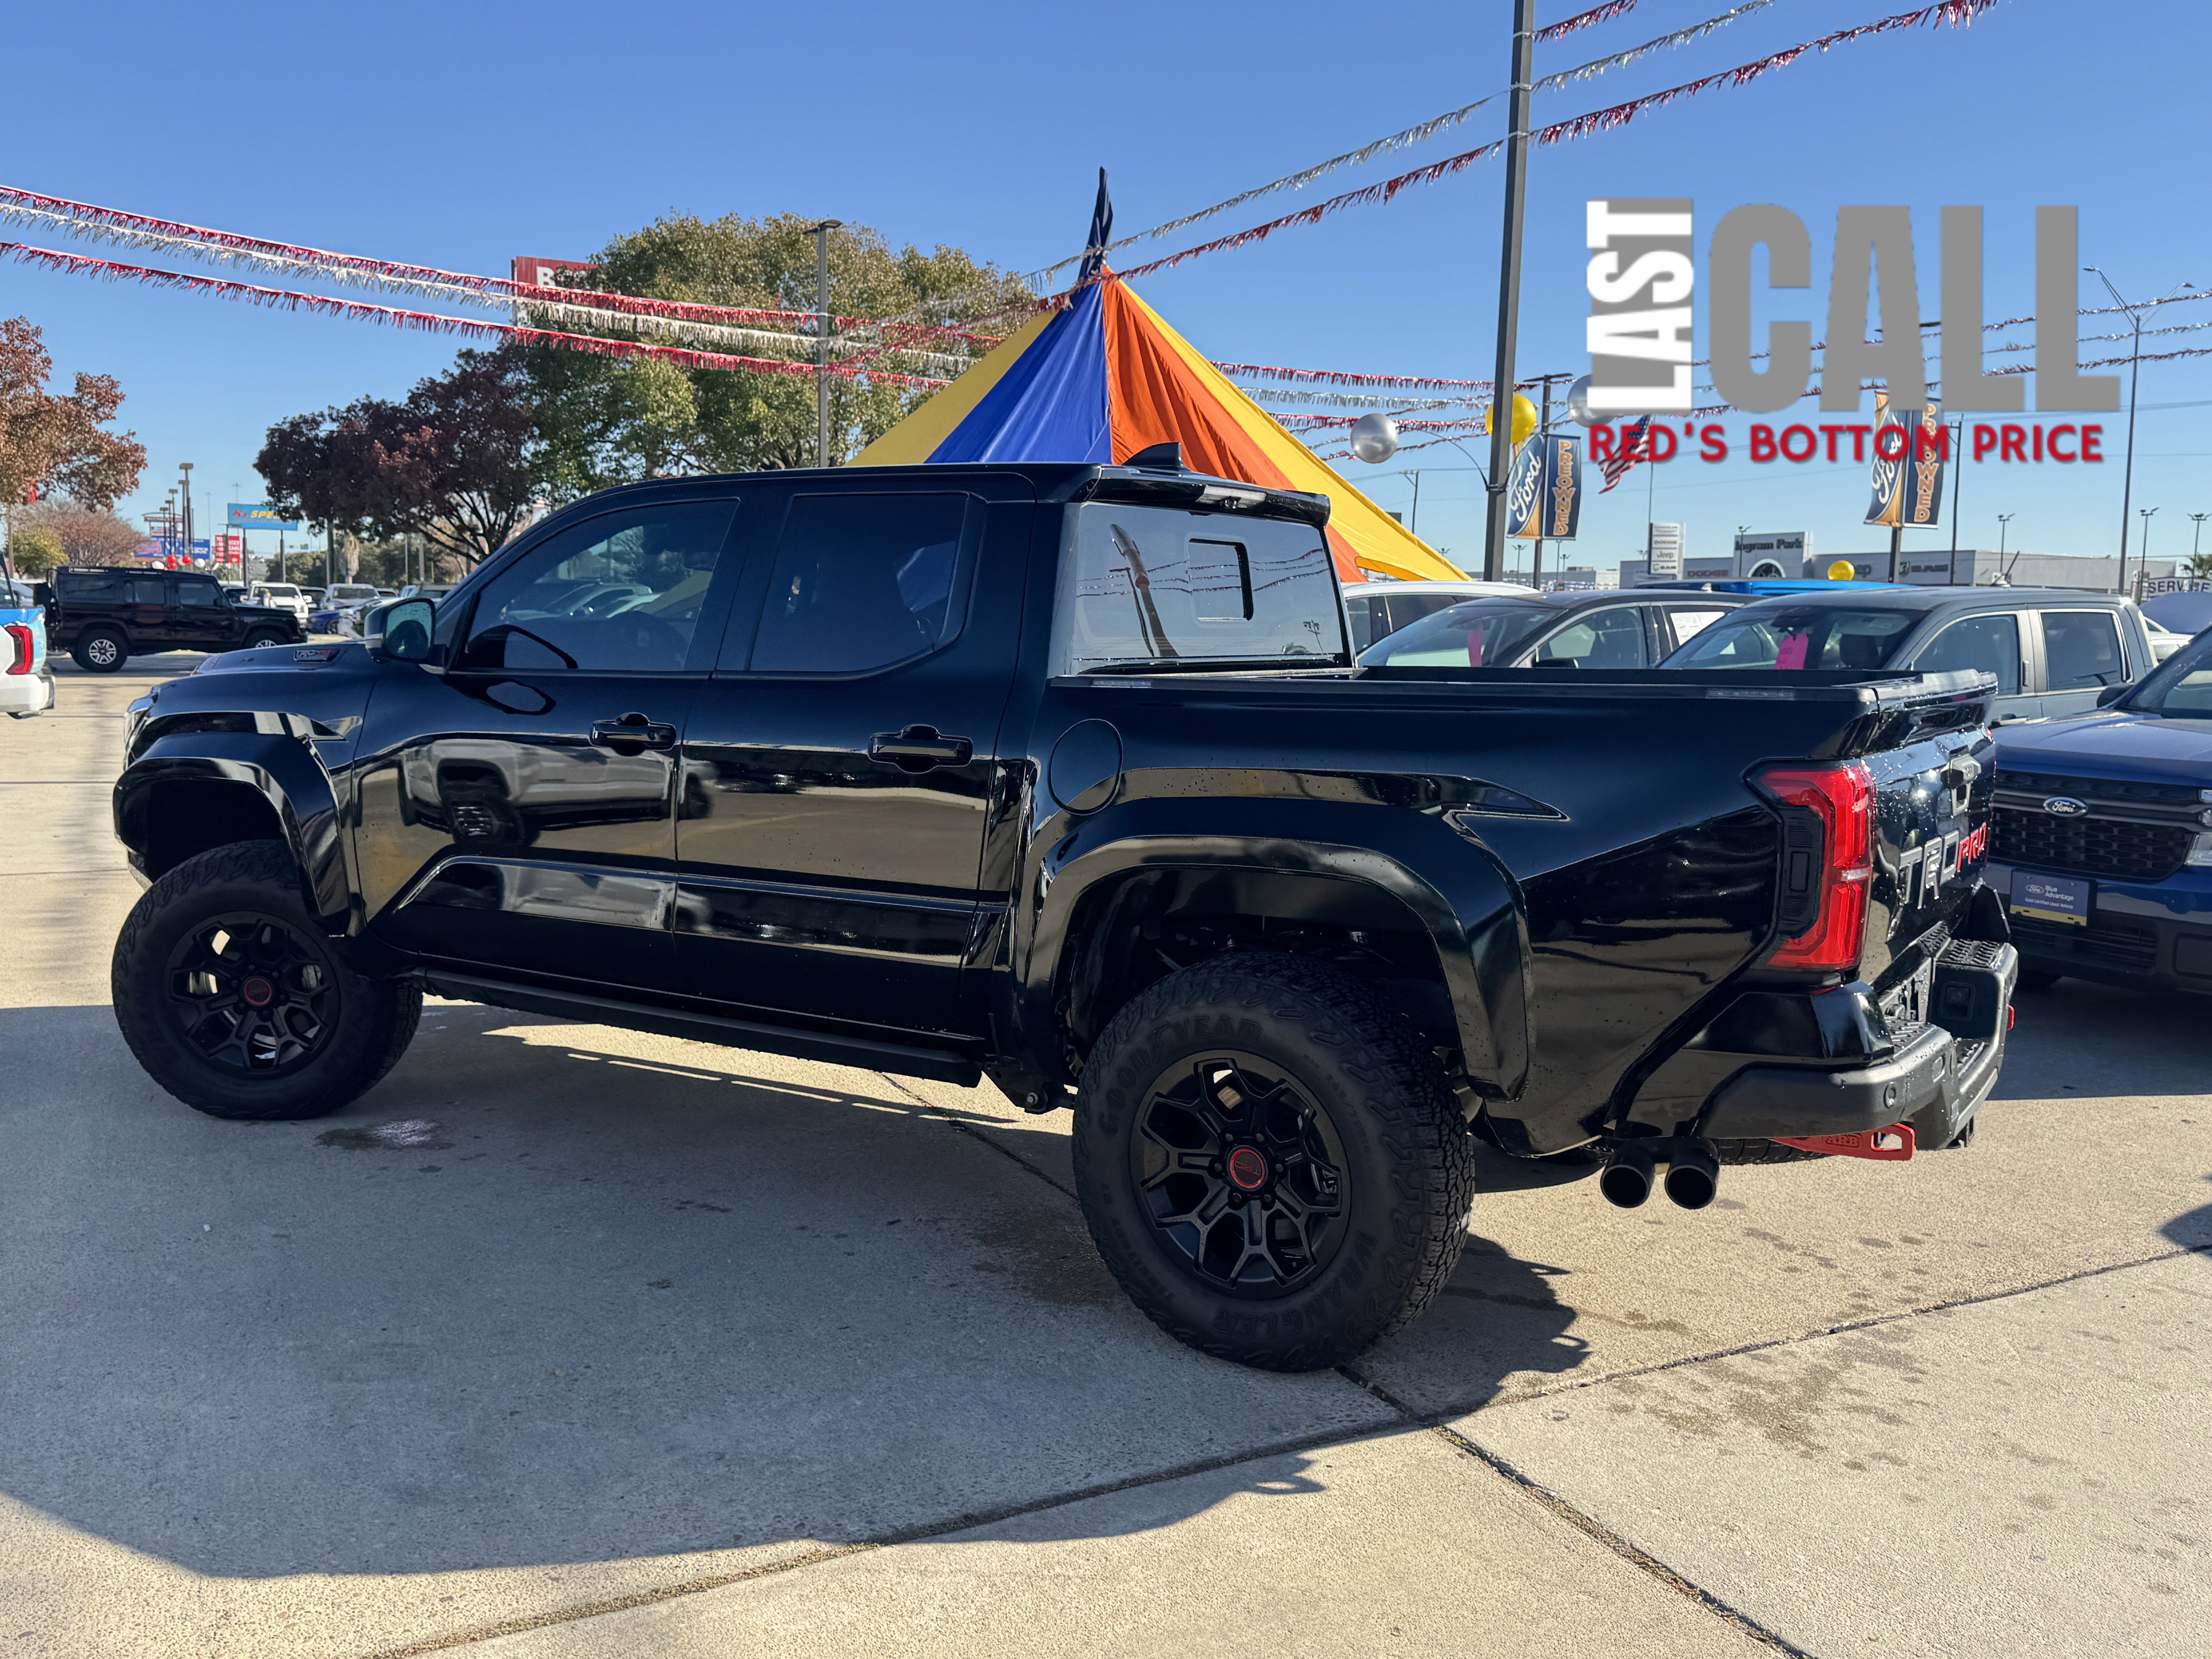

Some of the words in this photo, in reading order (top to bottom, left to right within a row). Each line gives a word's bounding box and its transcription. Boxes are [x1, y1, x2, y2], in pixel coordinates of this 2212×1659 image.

[1510, 450, 1542, 522] Ford
[1553, 440, 1576, 536] PREOWNED
[1914, 403, 1939, 522] PROWNED
[1687, 569, 1729, 577] DODGE
[1776, 538, 1802, 549] Park
[2052, 800, 2075, 812] Ford
[1899, 830, 1960, 910] TRD
[2045, 892, 2074, 902] Advantage
[1098, 1014, 1262, 1135] GOODYEAR
